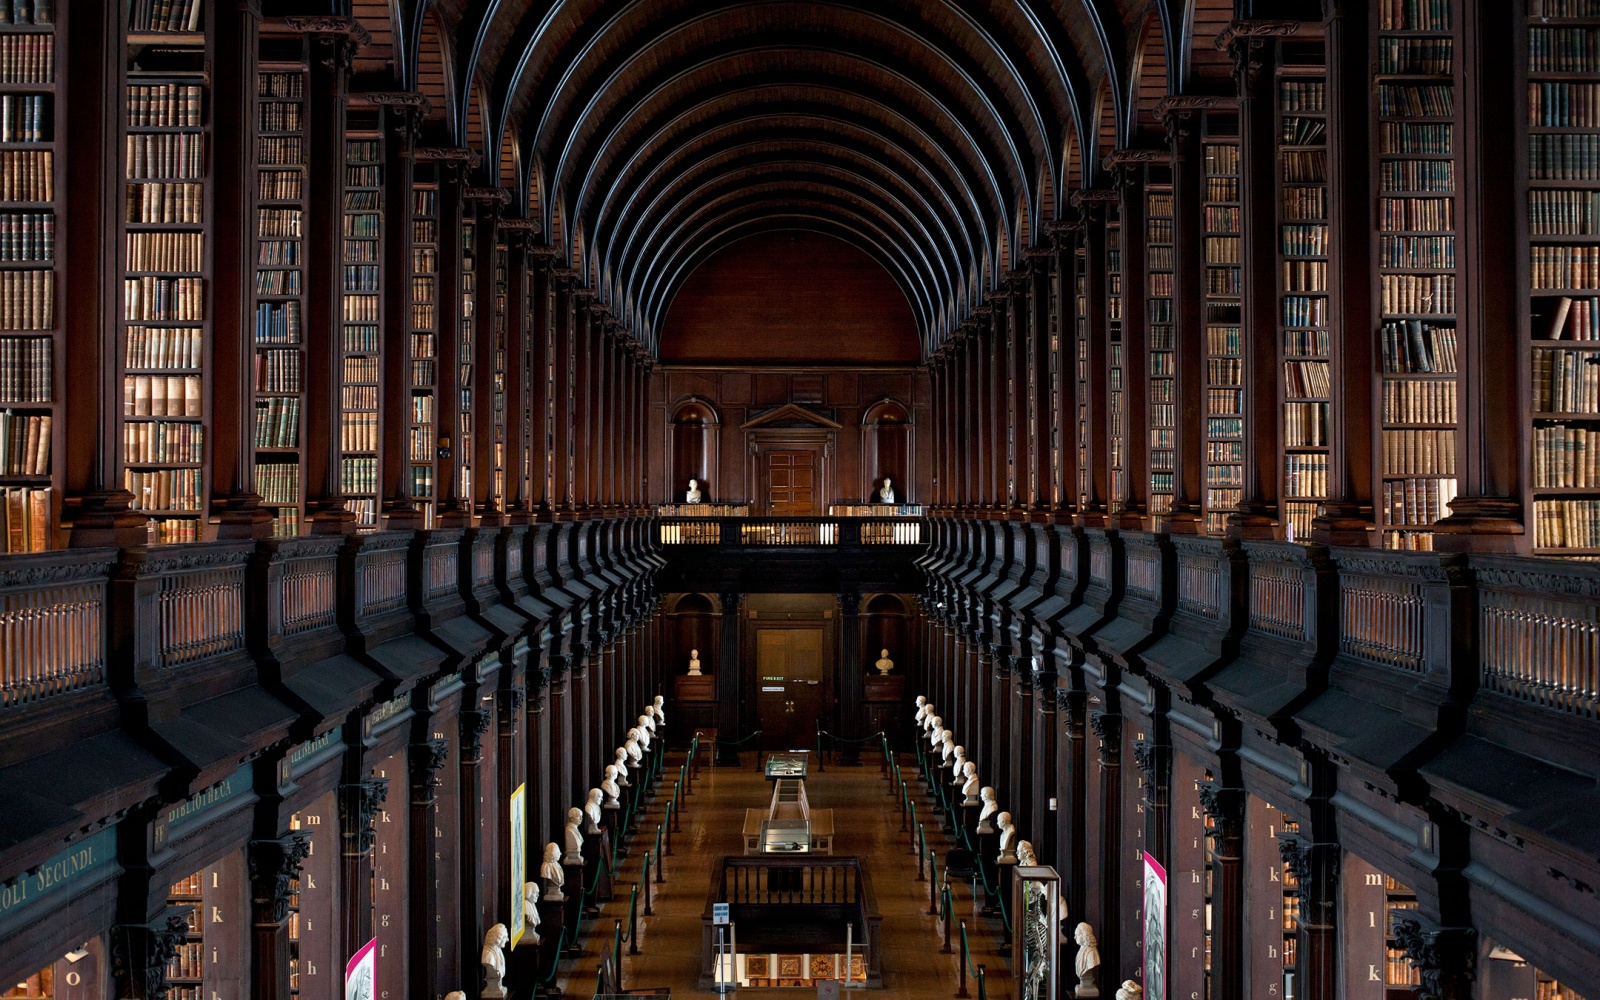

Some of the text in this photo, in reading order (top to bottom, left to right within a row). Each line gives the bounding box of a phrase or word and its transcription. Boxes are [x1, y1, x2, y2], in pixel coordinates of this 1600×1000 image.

[1136, 804, 1144, 813] k
[1191, 807, 1200, 819] k
[307, 815, 321, 825] m
[381, 811, 391, 823] k
[1269, 825, 1275, 838] l
[381, 842, 387, 854] i
[1193, 837, 1198, 849] i
[1136, 849, 1143, 860] h
[211, 872, 219, 888] l
[1191, 872, 1200, 883] h
[1269, 867, 1280, 882] k
[1365, 873, 1383, 886] m
[307, 874, 317, 889] k
[381, 878, 390, 891] h
[0, 880, 26, 911] OLI
[211, 907, 224, 923] k
[1192, 908, 1199, 919] g
[1269, 906, 1275, 920] i
[1368, 911, 1376, 928] l
[307, 918, 313, 931] i
[381, 914, 391, 928] g
[211, 946, 218, 964] i
[380, 944, 388, 958] f
[1191, 947, 1198, 958] f
[1268, 945, 1277, 958] h
[306, 960, 317, 975] h
[1368, 964, 1382, 981] k
[381, 990, 389, 999] e
[1191, 991, 1199, 1000] e
[1268, 982, 1277, 996] g
